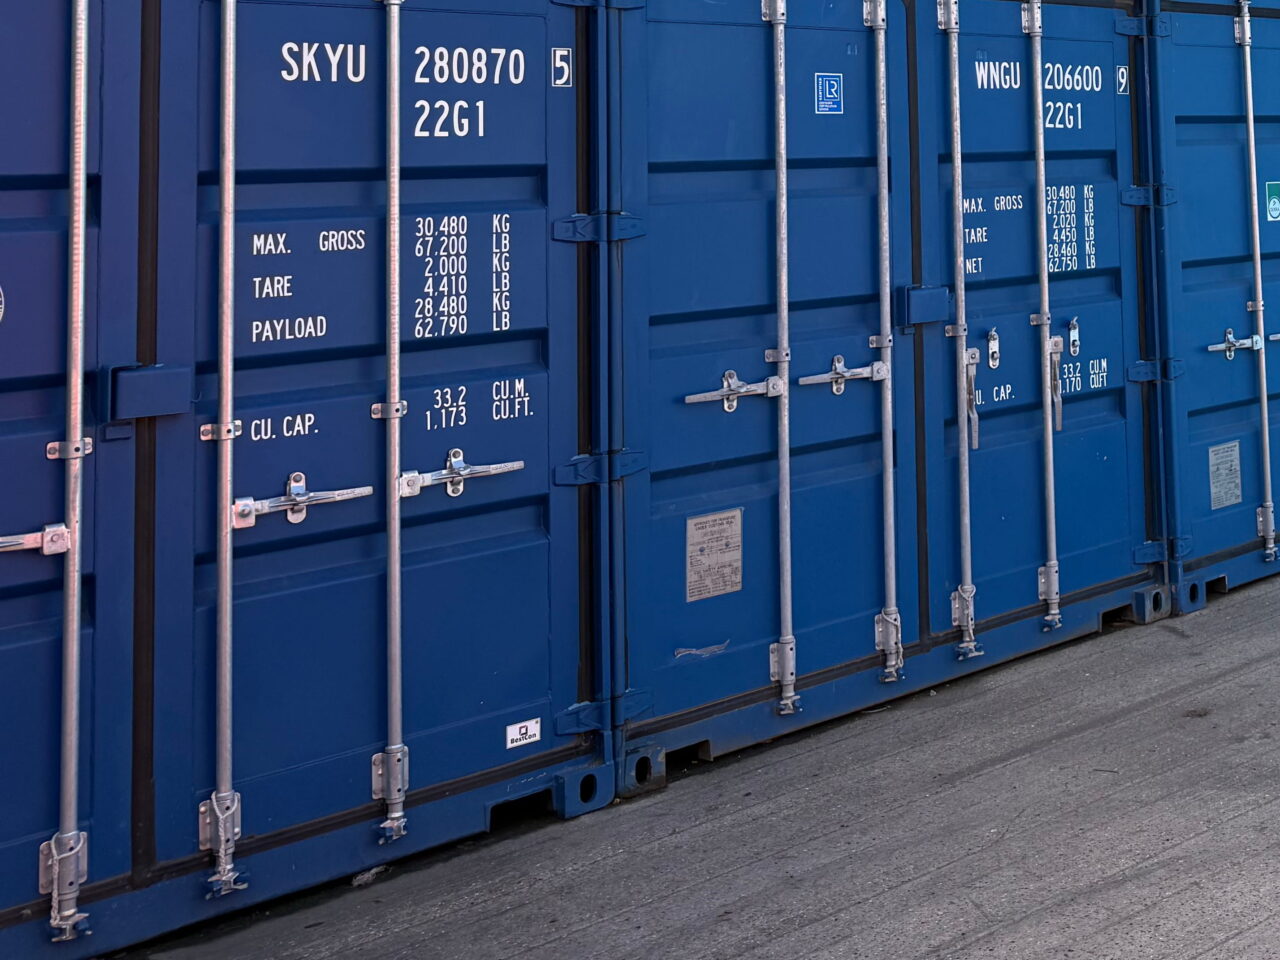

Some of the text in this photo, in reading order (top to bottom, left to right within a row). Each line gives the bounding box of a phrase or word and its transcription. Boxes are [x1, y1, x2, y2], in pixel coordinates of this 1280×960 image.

[281, 42, 569, 85] SKYU 280870 5
[975, 62, 1127, 93] WNGU 206600 9
[414, 100, 484, 137] 22G1
[1045, 102, 1082, 129] 22G1
[1084, 185, 1094, 199] KG
[963, 195, 1023, 213] MAX. GROSS
[1084, 199, 1094, 213] LB
[415, 214, 510, 236] 30,480 KG
[1084, 213, 1095, 227] KG
[253, 230, 365, 255] MAX. GROSS
[415, 233, 510, 256] 67,200 LB
[964, 227, 988, 243] TARE
[1085, 227, 1095, 241] LB
[1085, 241, 1096, 255] KG
[493, 253, 510, 272] KG
[966, 257, 983, 274] NET
[1086, 255, 1096, 269] LB
[253, 276, 292, 298] TARE
[493, 272, 510, 291] LB
[415, 292, 510, 318] 28,480 KG
[252, 316, 326, 342] PAYLOAD
[493, 311, 510, 331] LB
[1063, 362, 1081, 378] 33.2
[434, 378, 529, 408] 33.2 CU.M.
[973, 384, 1015, 405] U. CAP.
[426, 397, 533, 430] 1,173 CU.FT.
[251, 414, 319, 440] CU. CAP.
